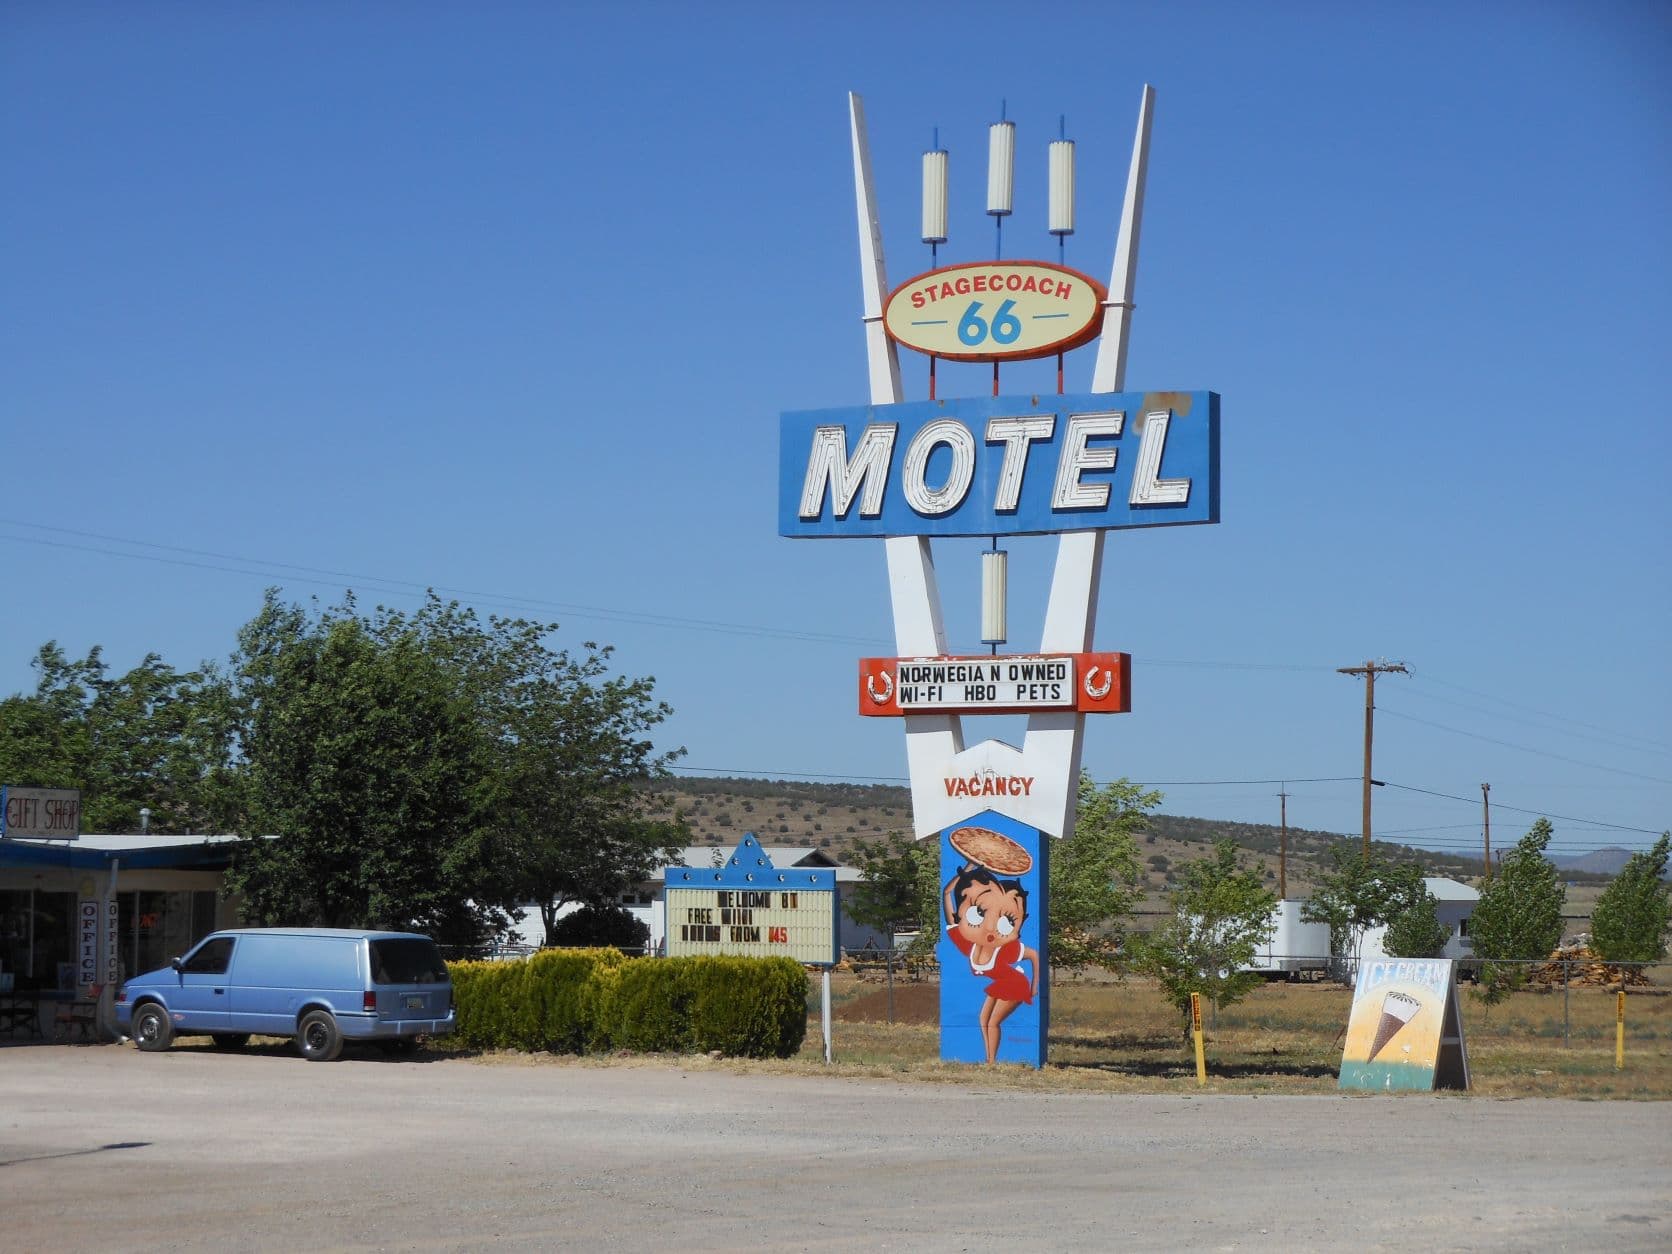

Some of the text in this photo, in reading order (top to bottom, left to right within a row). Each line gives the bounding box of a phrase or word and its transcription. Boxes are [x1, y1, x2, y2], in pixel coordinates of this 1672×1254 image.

[910, 274, 1073, 309] STAGECOACH
[957, 299, 1022, 346] 66
[798, 408, 1193, 521] MOTEL
[1008, 663, 1066, 682] OWNED
[900, 683, 1061, 704] WI-FI HBO PETS
[944, 776, 1035, 797] VACANCY
[6, 797, 79, 830] GIFT SHOP
[688, 907, 713, 924] FREE
[82, 905, 96, 982] OFFICE
[108, 904, 117, 981] OFFICE
[1362, 961, 1393, 992] ICE
